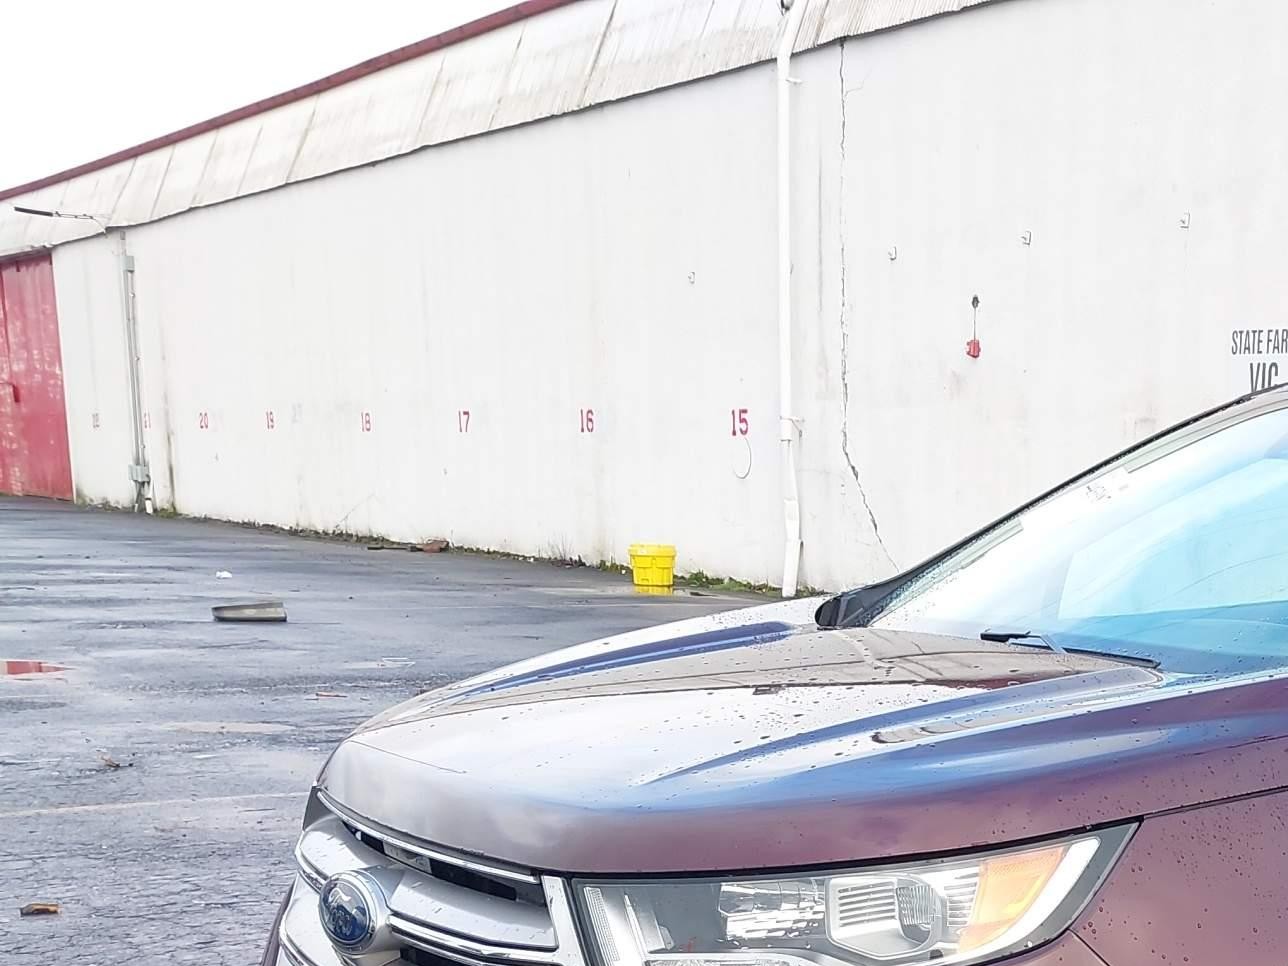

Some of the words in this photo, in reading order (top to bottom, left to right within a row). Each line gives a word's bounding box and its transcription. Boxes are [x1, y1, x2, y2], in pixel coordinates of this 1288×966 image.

[1231, 329, 1264, 355] STATE
[1249, 361, 1279, 391] VIC
[199, 411, 209, 430] 20
[265, 410, 275, 430] 19
[360, 411, 372, 433] 18
[458, 410, 471, 433] 17
[579, 408, 595, 433] 16
[731, 408, 749, 437] 15
